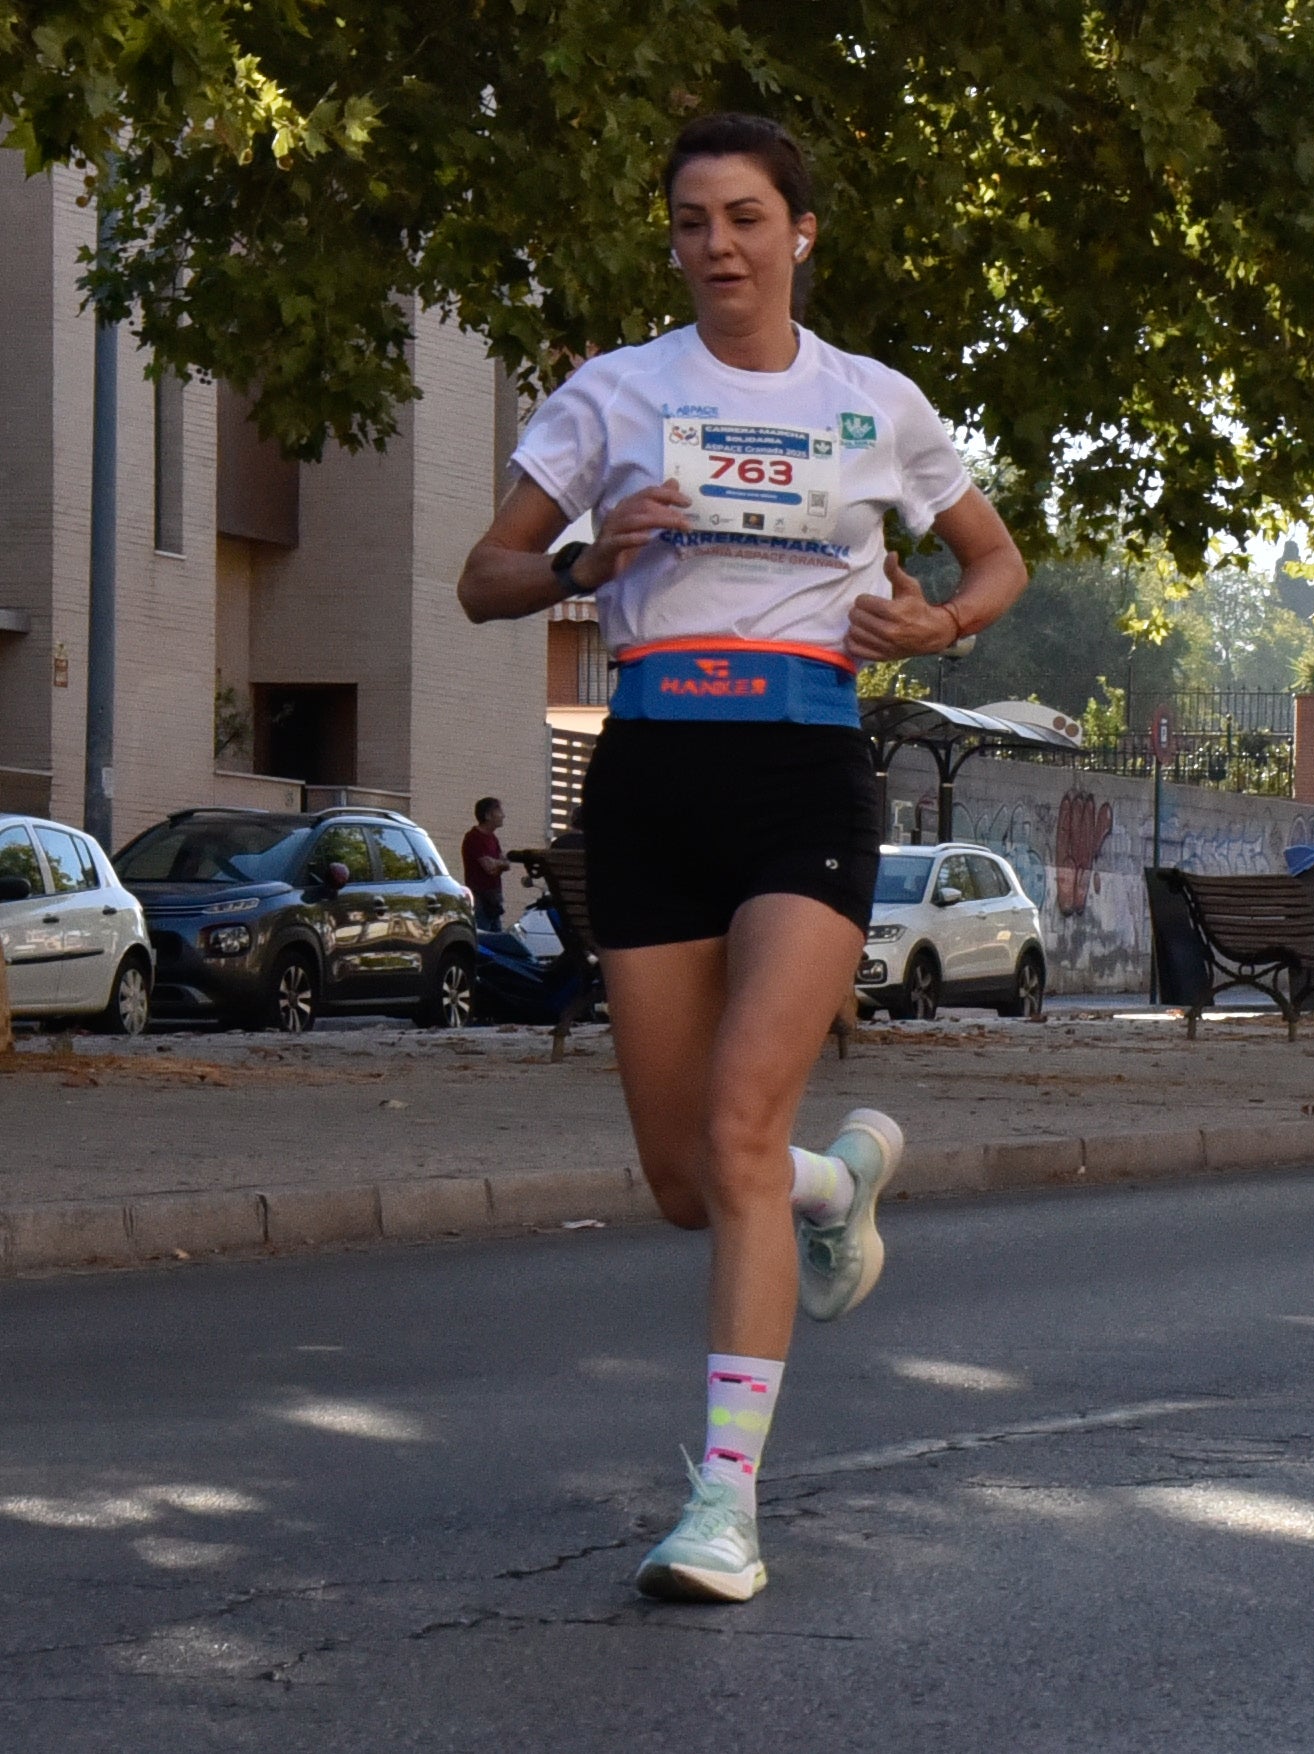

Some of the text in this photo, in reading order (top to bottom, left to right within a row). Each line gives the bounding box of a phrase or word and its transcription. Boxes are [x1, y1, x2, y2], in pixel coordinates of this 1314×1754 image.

[705, 426, 806, 439] CARRERA-MARCHA
[744, 445, 784, 455] Granada
[709, 455, 793, 486] 763
